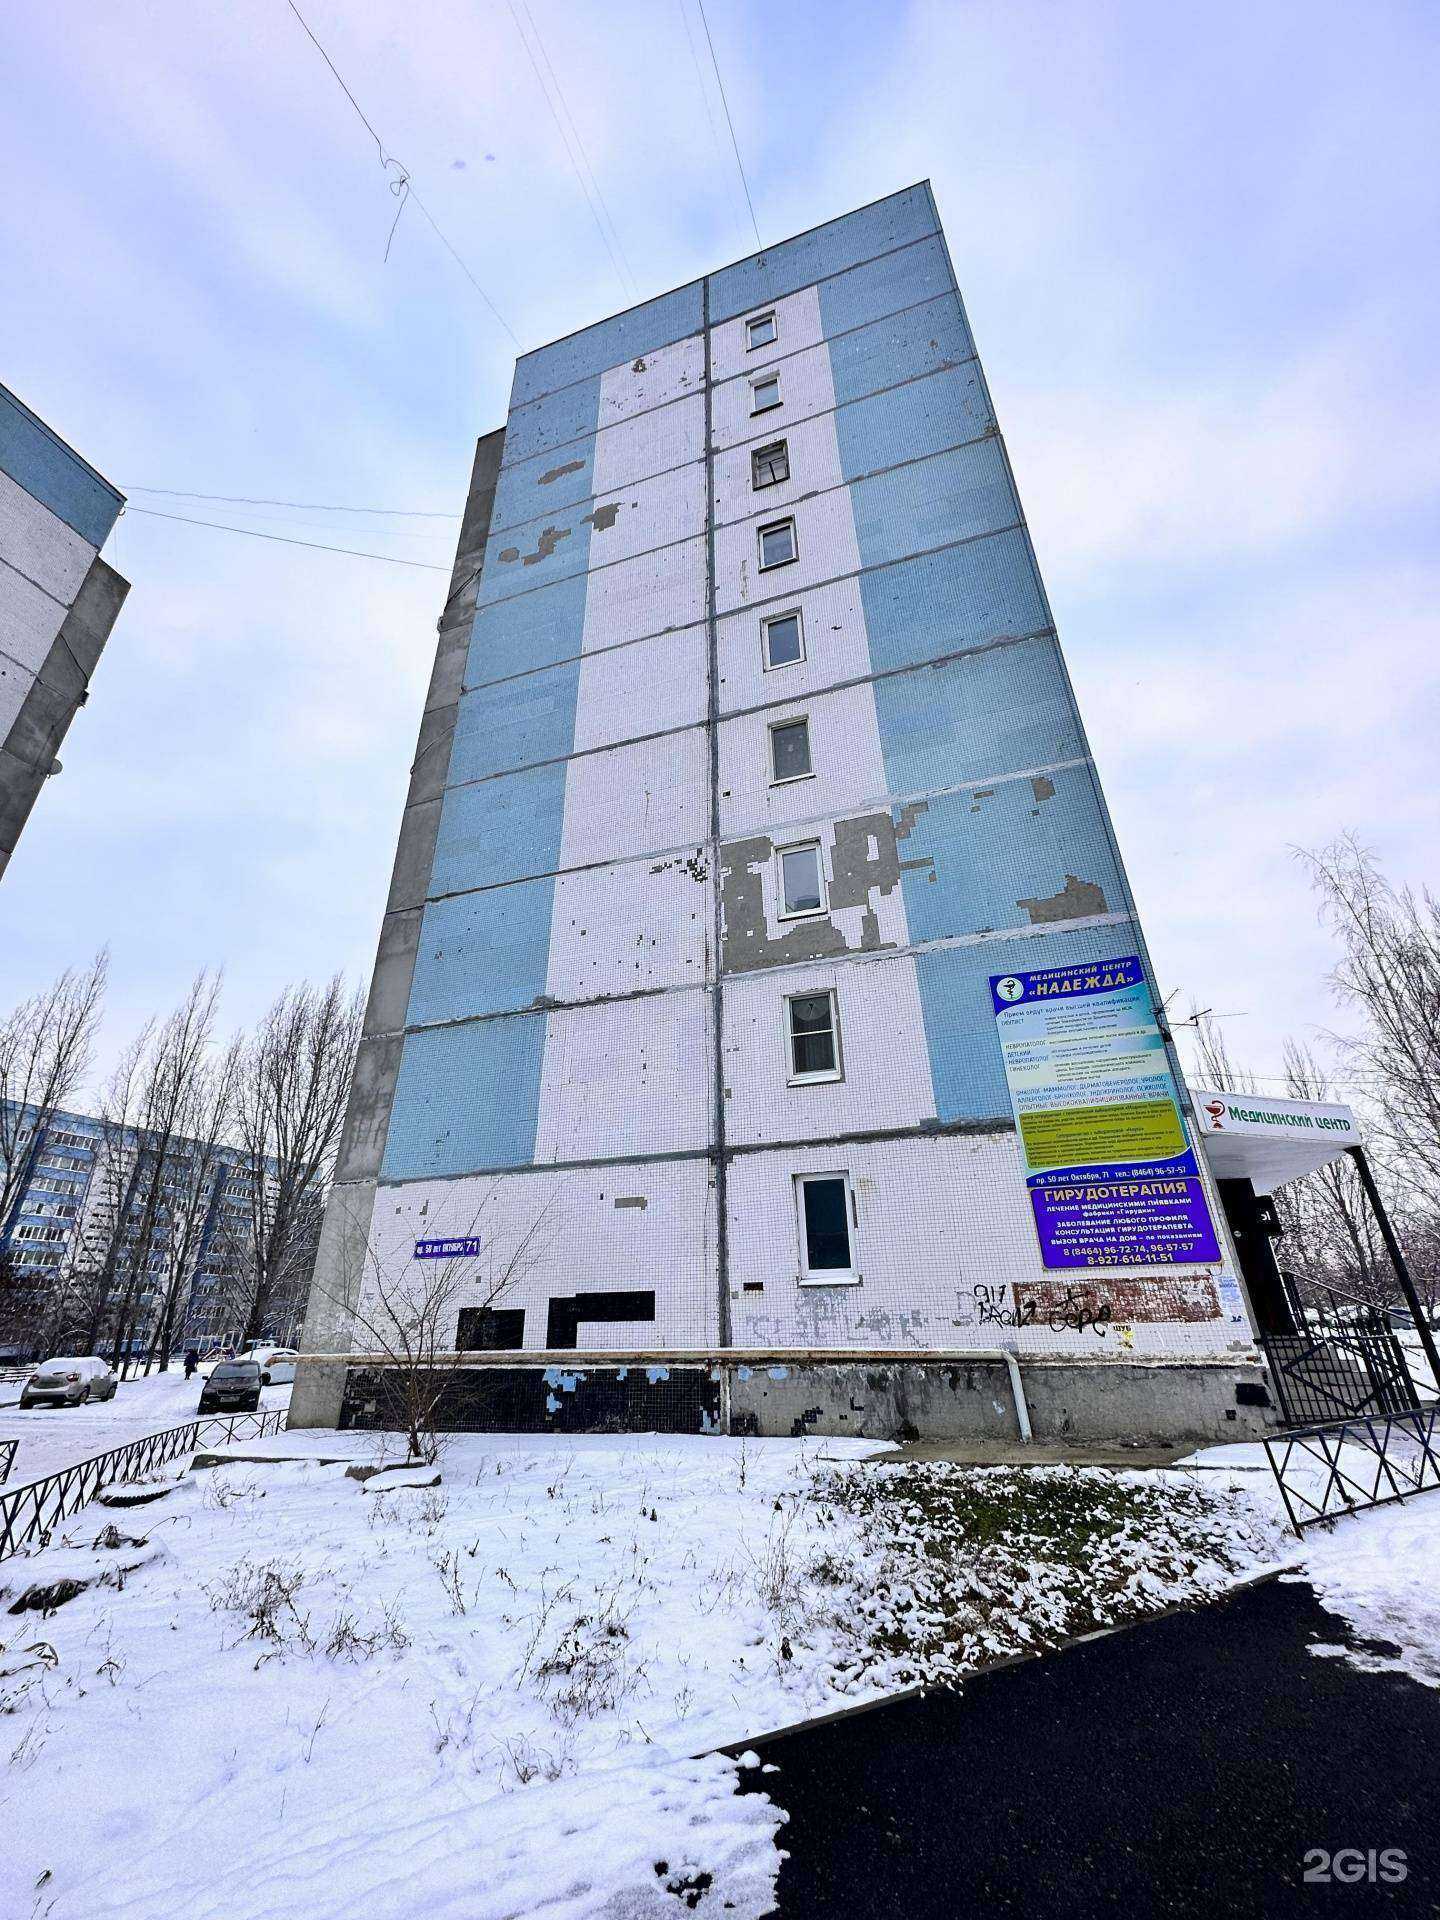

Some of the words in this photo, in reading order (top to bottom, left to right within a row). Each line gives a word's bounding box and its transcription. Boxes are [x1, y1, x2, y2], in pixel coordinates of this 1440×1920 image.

[1029, 965, 1098, 982] МЕДИЦИНСКИЙ
[1102, 961, 1132, 972] ЦЕНТР
[1029, 972, 1134, 996] «НАДЕЖДА»
[1228, 1105, 1314, 1128] Медицинский
[1316, 1116, 1351, 1132] центр
[1047, 1175, 1057, 1183] 50
[1131, 1168, 1154, 1178] (8464)
[1154, 1165, 1186, 1176] 96-57-57
[1044, 1181, 1188, 1202] ГИРУДОТЕРАПИЯ
[1046, 1204, 1080, 1213] ЛЕЧЕНИЕ
[1081, 1199, 1146, 1211] МЕДИЦИНСКИМИ
[1147, 1197, 1192, 1207] ПИЯВКАМИ
[1056, 1219, 1112, 1228] ЗАБОЛЕВАНИЕ
[1113, 1217, 1147, 1225] ЛЮБОГО
[1148, 1214, 1189, 1223] ПРОФИЛЯ
[1082, 1210, 1115, 1218] фабрики
[1055, 1226, 1116, 1236] КОНСУЛЬТАЦИЯ
[1117, 1222, 1194, 1233] ГИРУДОТЕРАПЕВТА
[465, 1240, 478, 1252] 71
[1050, 1237, 1078, 1245] ВЫЗОВ
[1079, 1236, 1105, 1244] ВРАЧА
[1119, 1235, 1137, 1243] ДОМ
[1063, 1248, 1070, 1256] 8
[1071, 1247, 1103, 1257] (8464)
[1103, 1245, 1149, 1254] 96-72-74,
[1150, 1243, 1194, 1252] 96-57-57
[1087, 1253, 1174, 1265] 8-927-614-11-51
